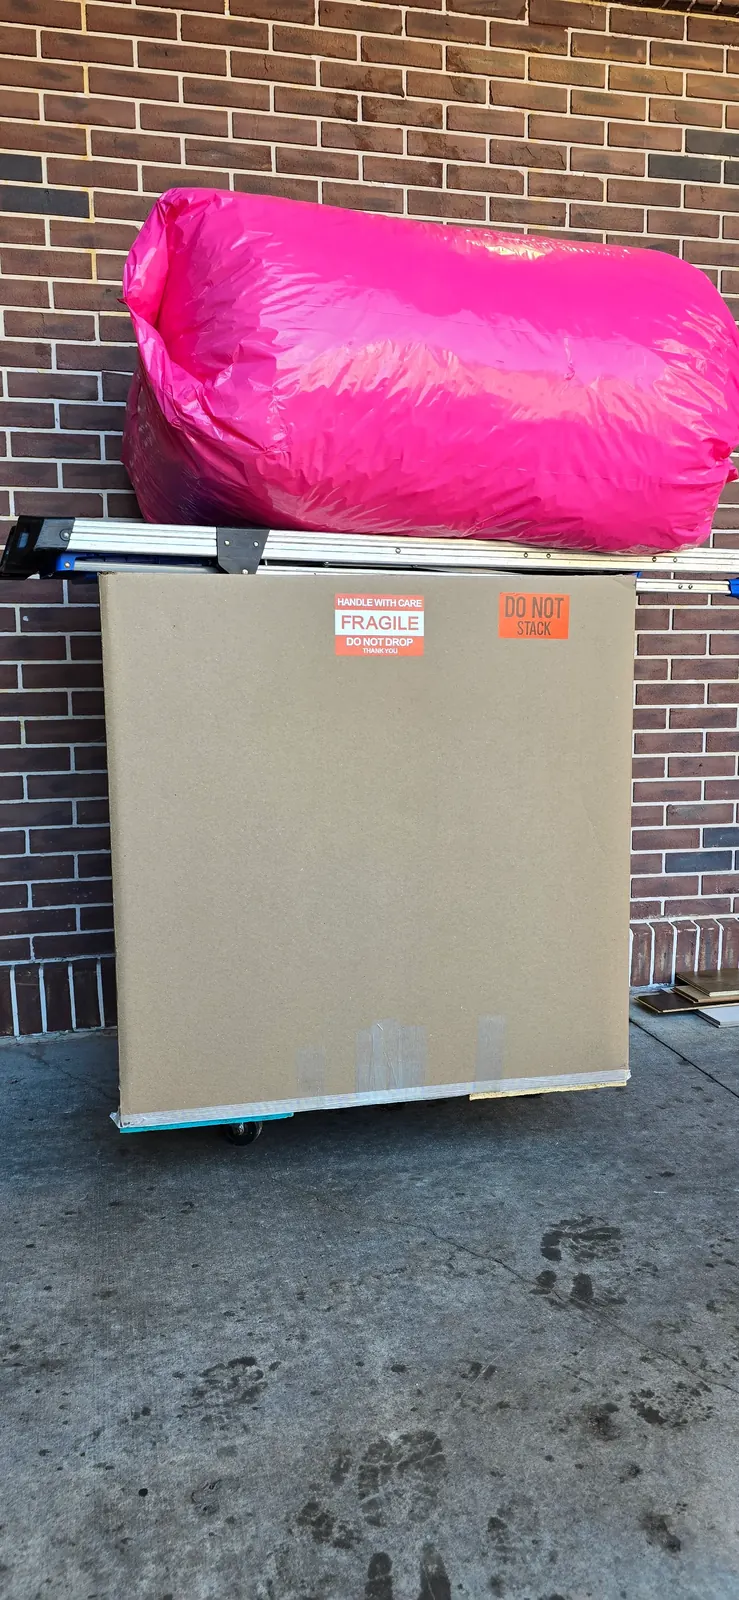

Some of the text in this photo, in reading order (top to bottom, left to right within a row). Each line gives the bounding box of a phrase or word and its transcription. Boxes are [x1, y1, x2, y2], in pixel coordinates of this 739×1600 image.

[337, 597, 422, 608] HANDLE WITH CARE
[505, 595, 564, 618] DO NOT
[341, 615, 419, 631] FRAGILE
[517, 620, 551, 636] STACK
[346, 637, 413, 647] DO NOT DROP
